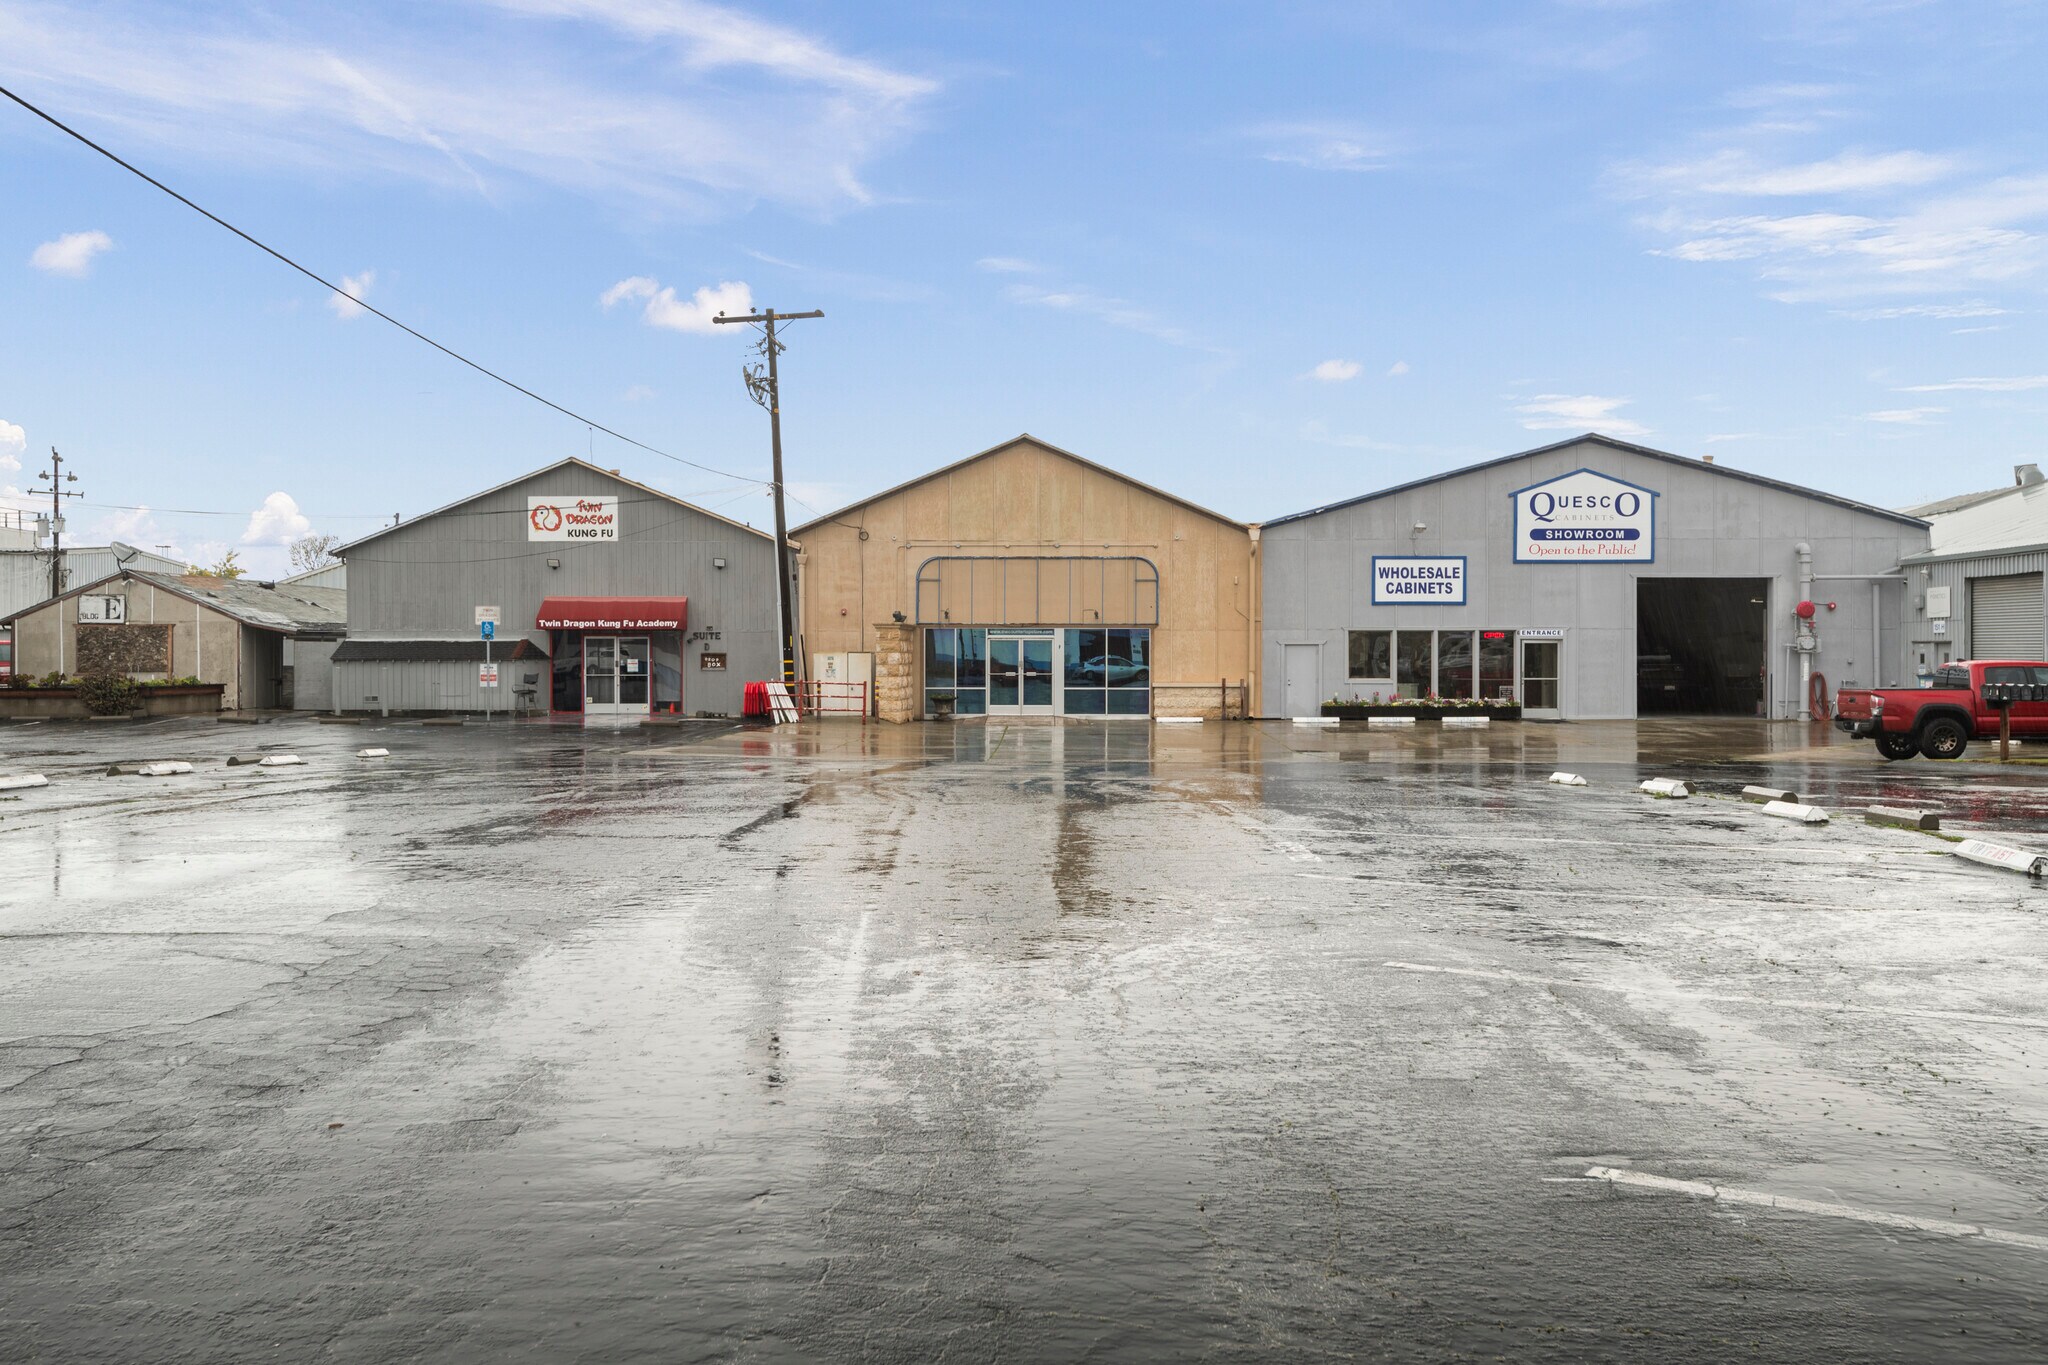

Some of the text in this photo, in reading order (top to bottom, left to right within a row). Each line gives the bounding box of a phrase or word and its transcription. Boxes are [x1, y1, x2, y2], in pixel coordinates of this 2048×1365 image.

[576, 500, 602, 512] TWIN
[1529, 492, 1640, 523] QUESCO
[565, 514, 613, 525] DRAGON
[567, 529, 614, 538] KUNG FU
[1545, 530, 1625, 539] SHOWROOM
[1528, 544, 1637, 556] Open to the Public!
[1378, 567, 1461, 579] WHOLESALE
[1386, 582, 1453, 594] CABINETS
[105, 599, 120, 619] E
[563, 620, 595, 629] Dragon
[598, 620, 621, 629] Kung
[636, 620, 678, 628] Academy
[692, 631, 721, 640] SUITE
[704, 643, 710, 651] D
